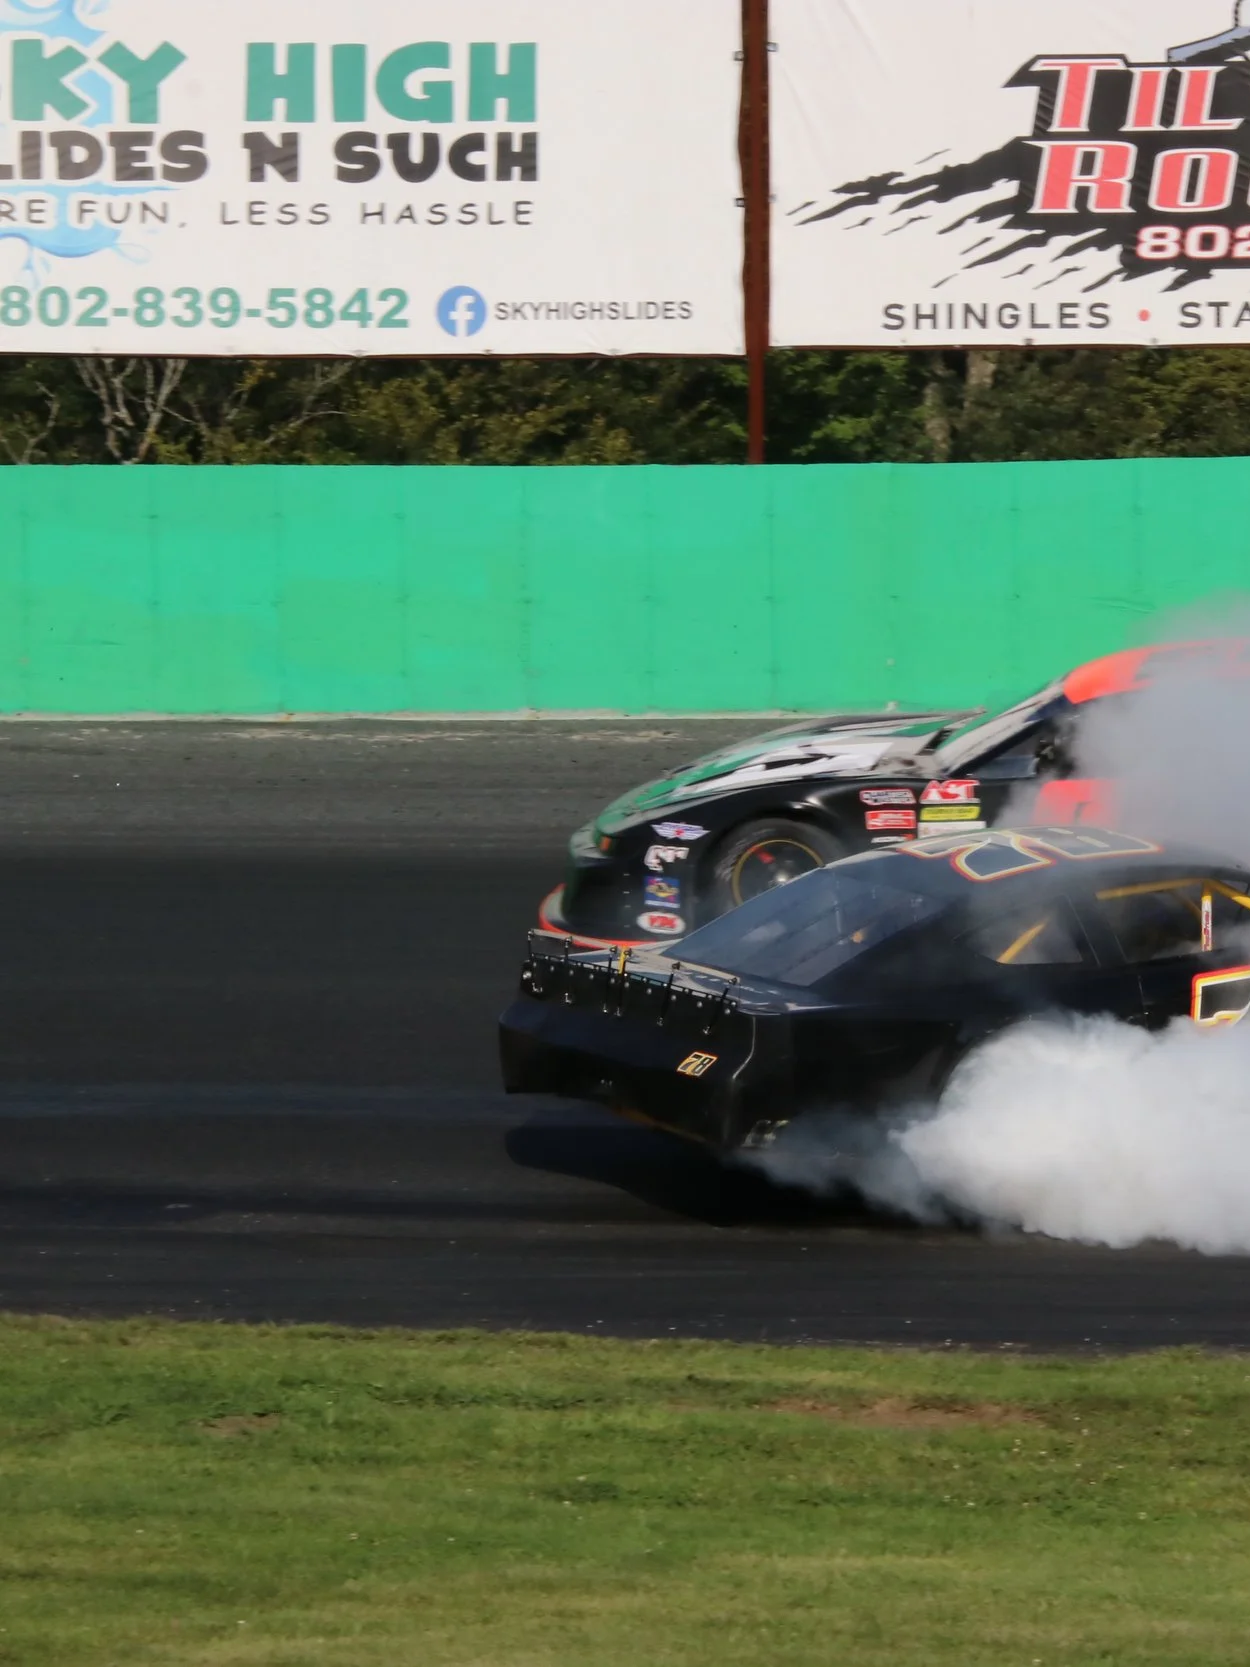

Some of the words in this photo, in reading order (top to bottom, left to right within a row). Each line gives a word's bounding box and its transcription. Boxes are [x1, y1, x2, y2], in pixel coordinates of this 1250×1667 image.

[245, 41, 537, 123] HIGH
[0, 129, 209, 182] IDES
[243, 132, 299, 182] N
[333, 131, 539, 183] SUCH
[219, 202, 331, 225] LESS
[361, 201, 533, 225] HASSLE
[0, 285, 411, 328] 802-839-5842
[494, 301, 693, 321] SKYHIGHSLIDES
[882, 302, 1111, 330] SHINGLES
[677, 1051, 717, 1077] 78
